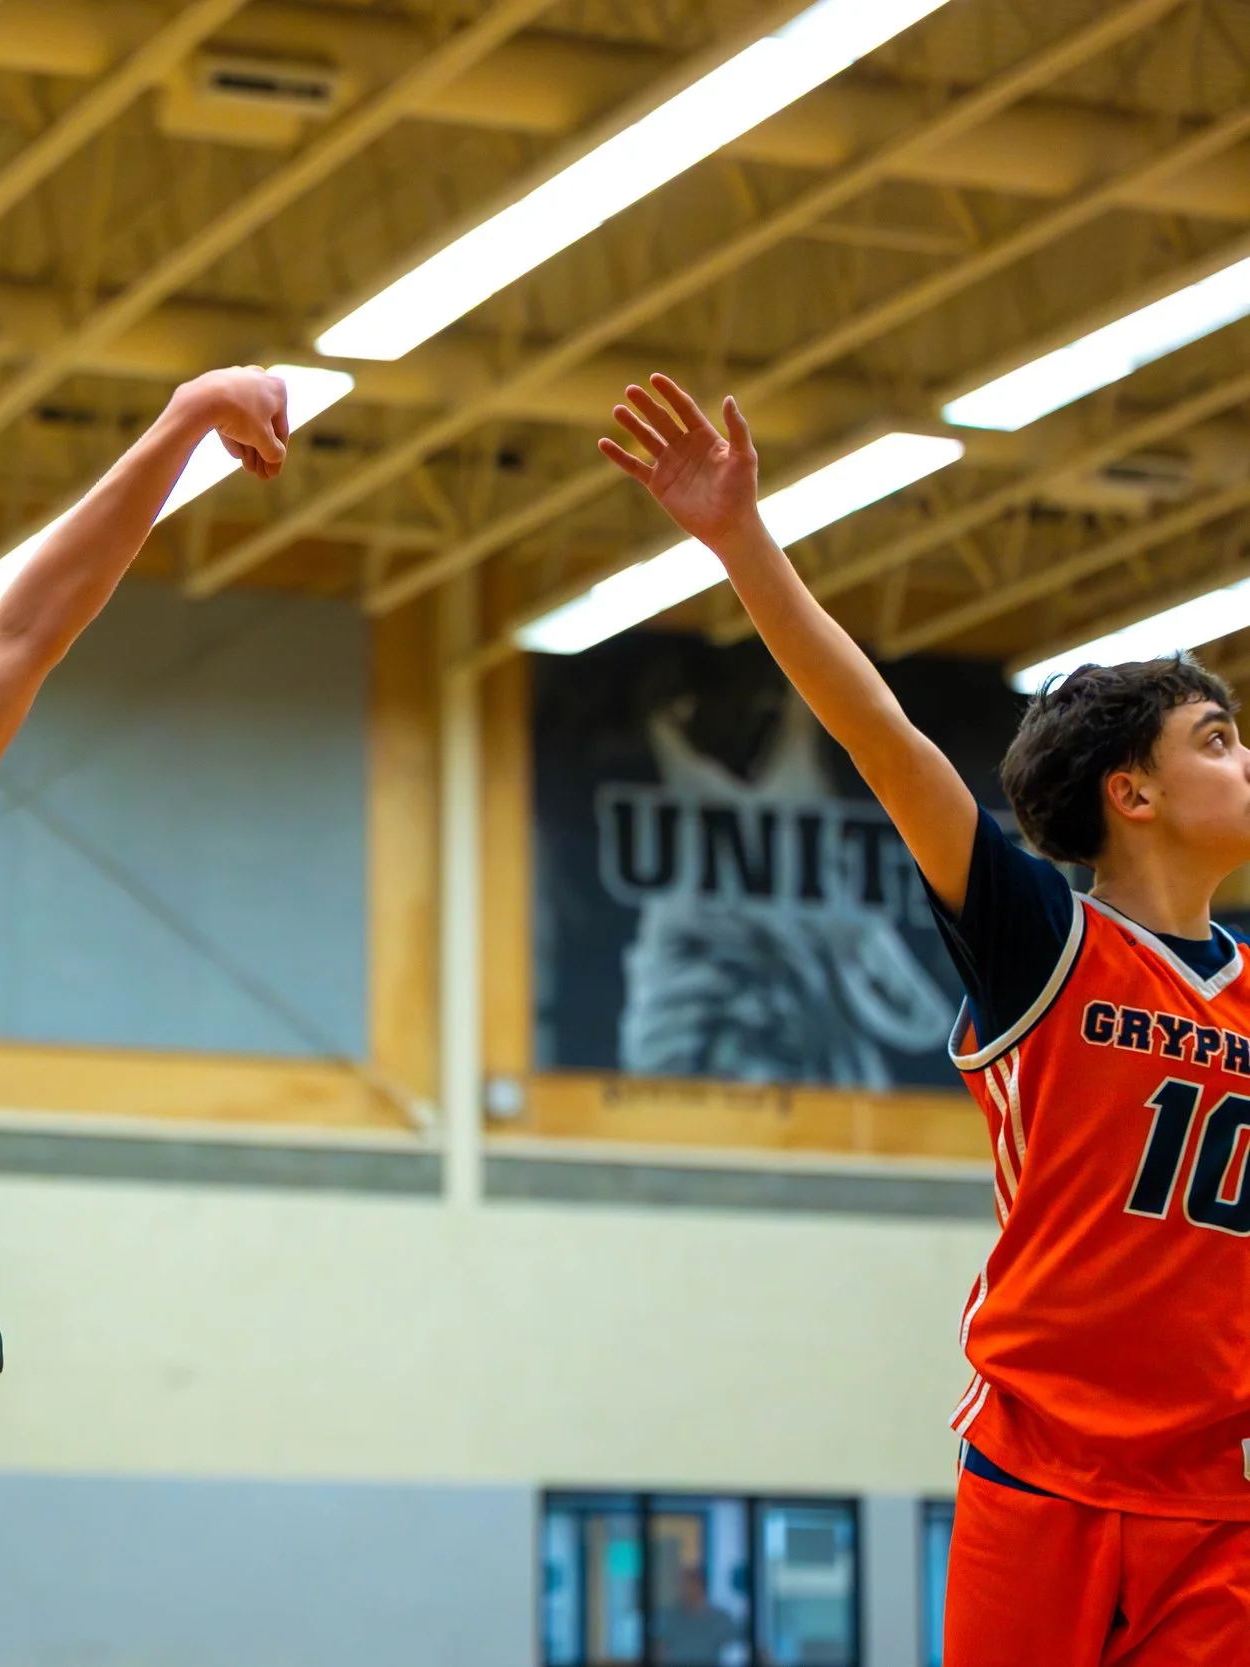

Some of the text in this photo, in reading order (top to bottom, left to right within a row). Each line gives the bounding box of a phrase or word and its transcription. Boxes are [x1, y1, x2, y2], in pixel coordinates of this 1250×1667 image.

[596, 784, 924, 914] UNIT
[1081, 999, 1250, 1078] GRYPH
[1122, 1075, 1250, 1237] 10
